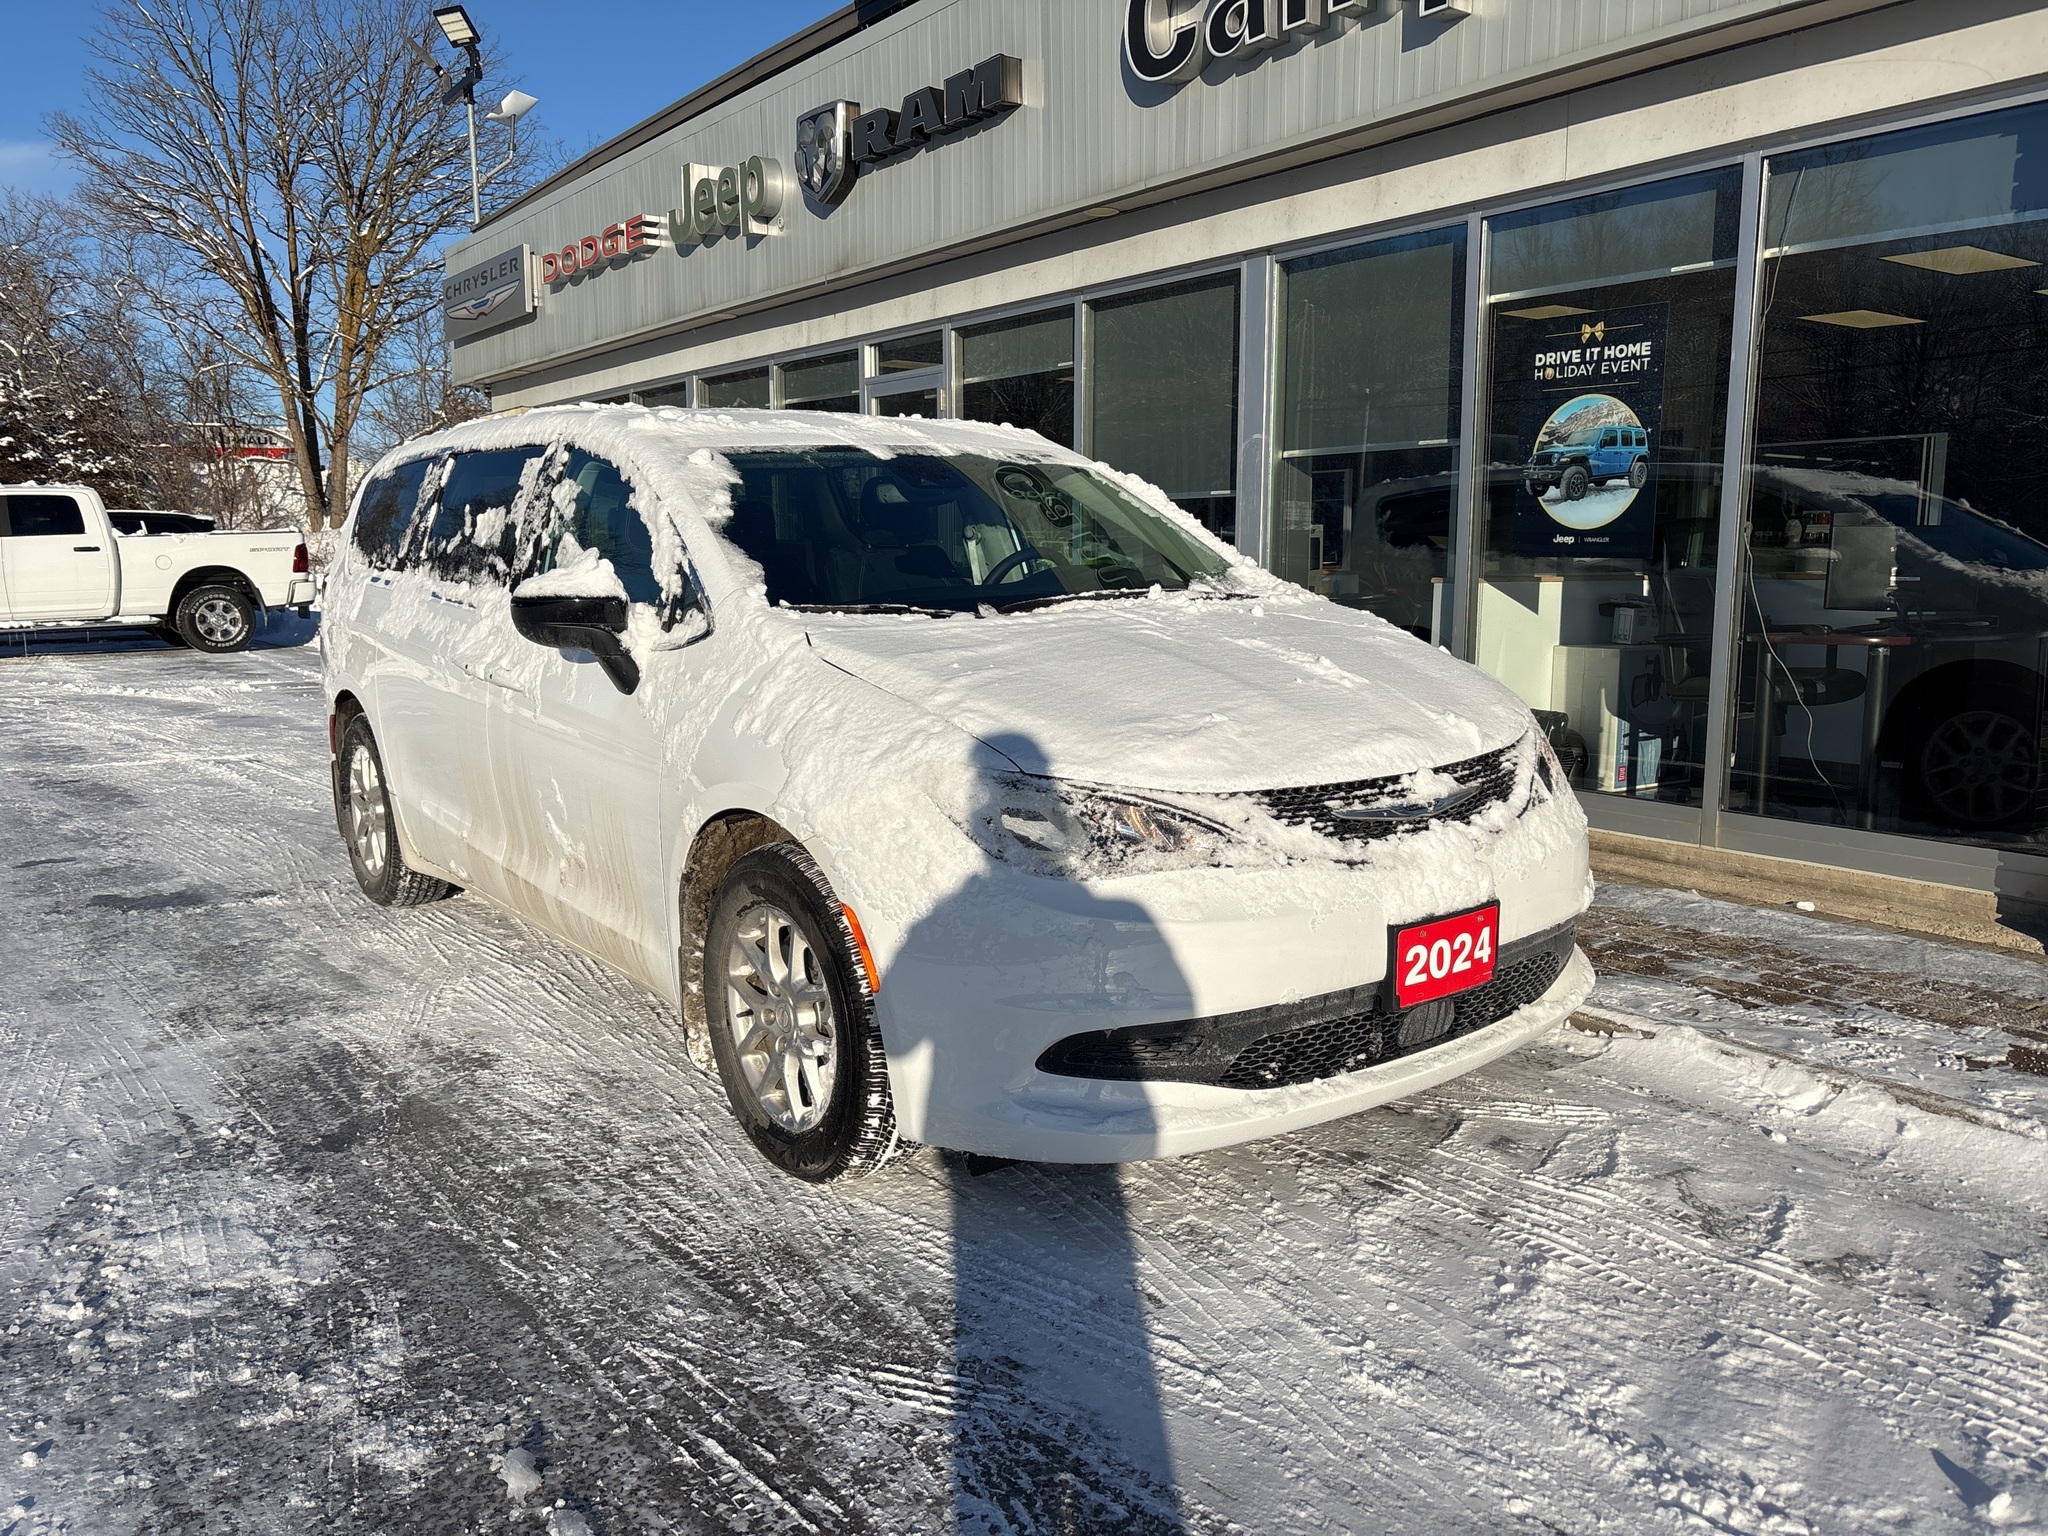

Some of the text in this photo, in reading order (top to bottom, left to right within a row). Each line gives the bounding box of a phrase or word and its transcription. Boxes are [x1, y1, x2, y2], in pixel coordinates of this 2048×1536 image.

[851, 53, 1008, 162] RAM
[666, 155, 768, 245] Jeep
[540, 213, 648, 284] DODGE
[444, 256, 519, 301] CHRYSLER
[1534, 341, 1652, 367] DRIVE IT HOME
[1534, 357, 1651, 381] HOLIDAY EVENT
[1552, 533, 1575, 545] Jeep
[1403, 924, 1492, 987] 2024
